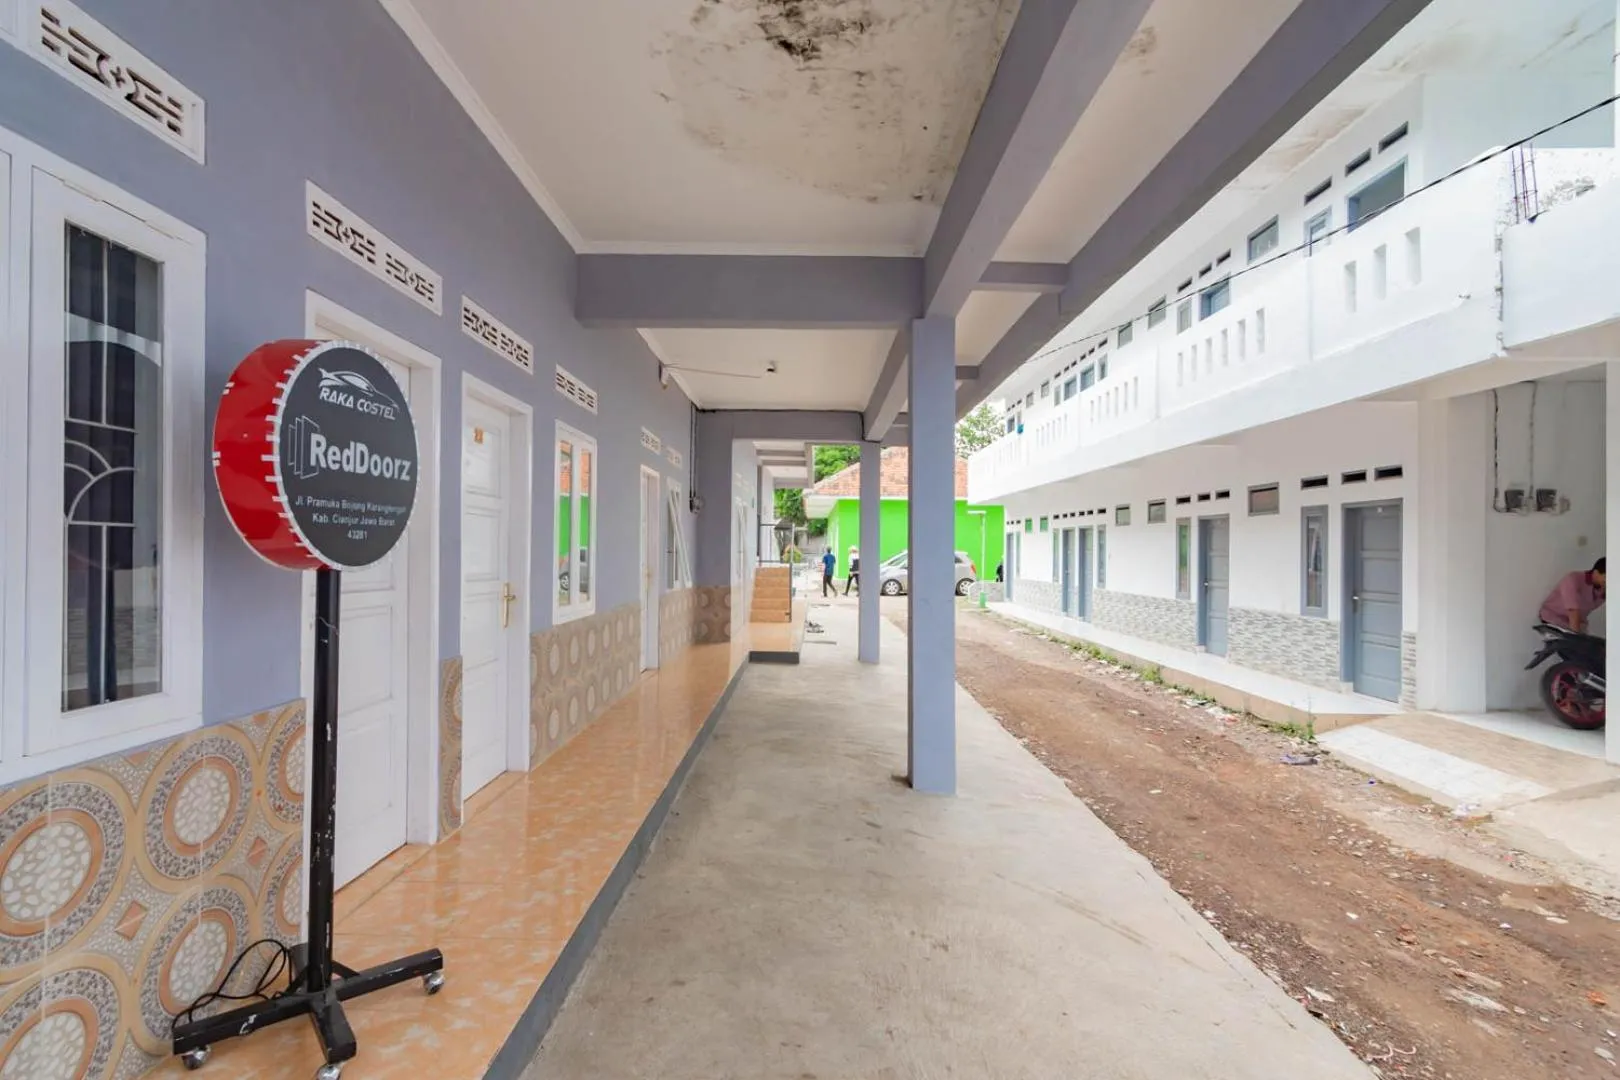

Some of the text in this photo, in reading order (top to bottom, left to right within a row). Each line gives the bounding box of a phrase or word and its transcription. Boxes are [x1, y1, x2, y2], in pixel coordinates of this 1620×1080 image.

[319, 386, 396, 421] RAKA COSTEL
[310, 432, 411, 481] RedDoorz
[307, 496, 340, 508] Pramuka
[332, 513, 359, 527] Cianjur
[360, 516, 377, 526] Jawa
